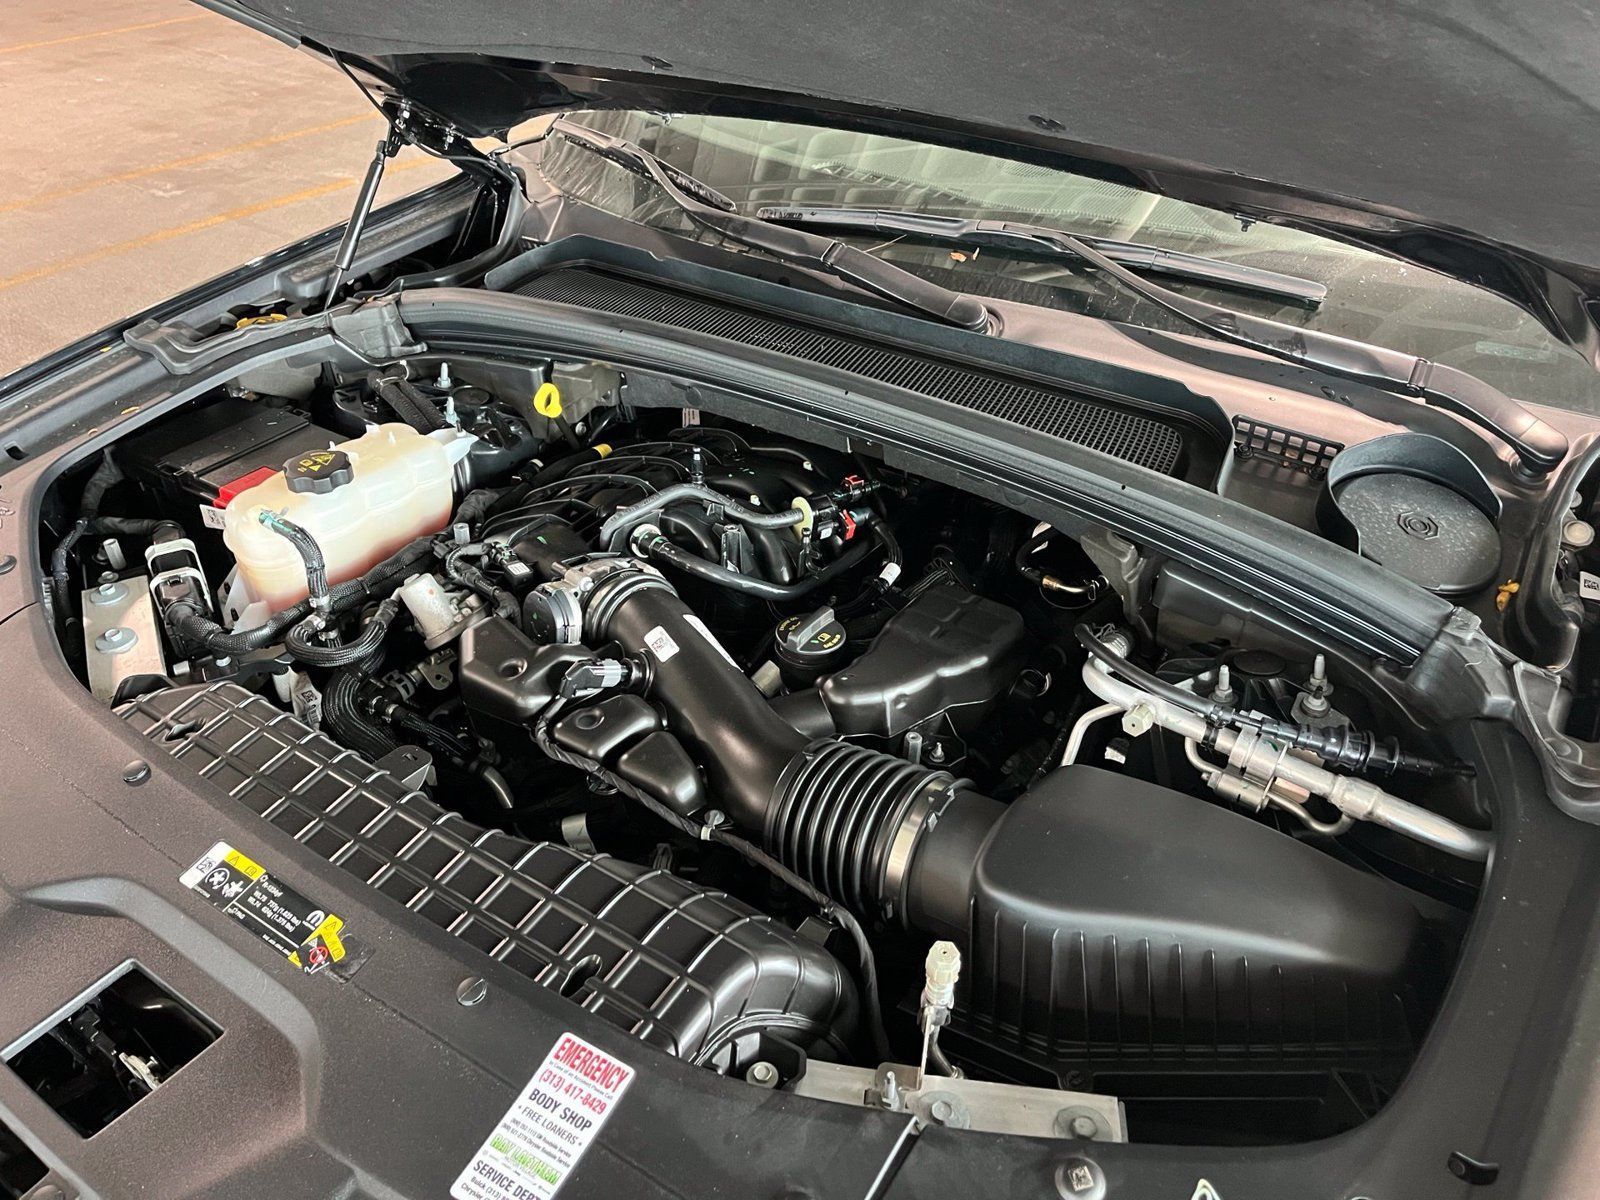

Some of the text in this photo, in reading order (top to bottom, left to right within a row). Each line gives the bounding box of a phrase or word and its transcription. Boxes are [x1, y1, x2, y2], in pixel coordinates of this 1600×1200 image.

[552, 1037, 629, 1093] EMERGENCY
[537, 1068, 608, 1115] (313) 417-8429
[603, 1092, 613, 1100] Call
[520, 1106, 578, 1145] FREE LOANERS
[527, 1088, 593, 1133] BODY SHOP
[489, 1133, 515, 1155] RAY
[526, 1138, 542, 1150] Chrysler
[540, 1147, 557, 1160] Roadside
[556, 1156, 571, 1168] Service
[541, 1136, 559, 1149] Roadside
[557, 1146, 572, 1157] Service
[470, 1176, 502, 1199] Buick (313)
[472, 1159, 515, 1191] SERVICE
[460, 1182, 483, 1200] Chrysler
